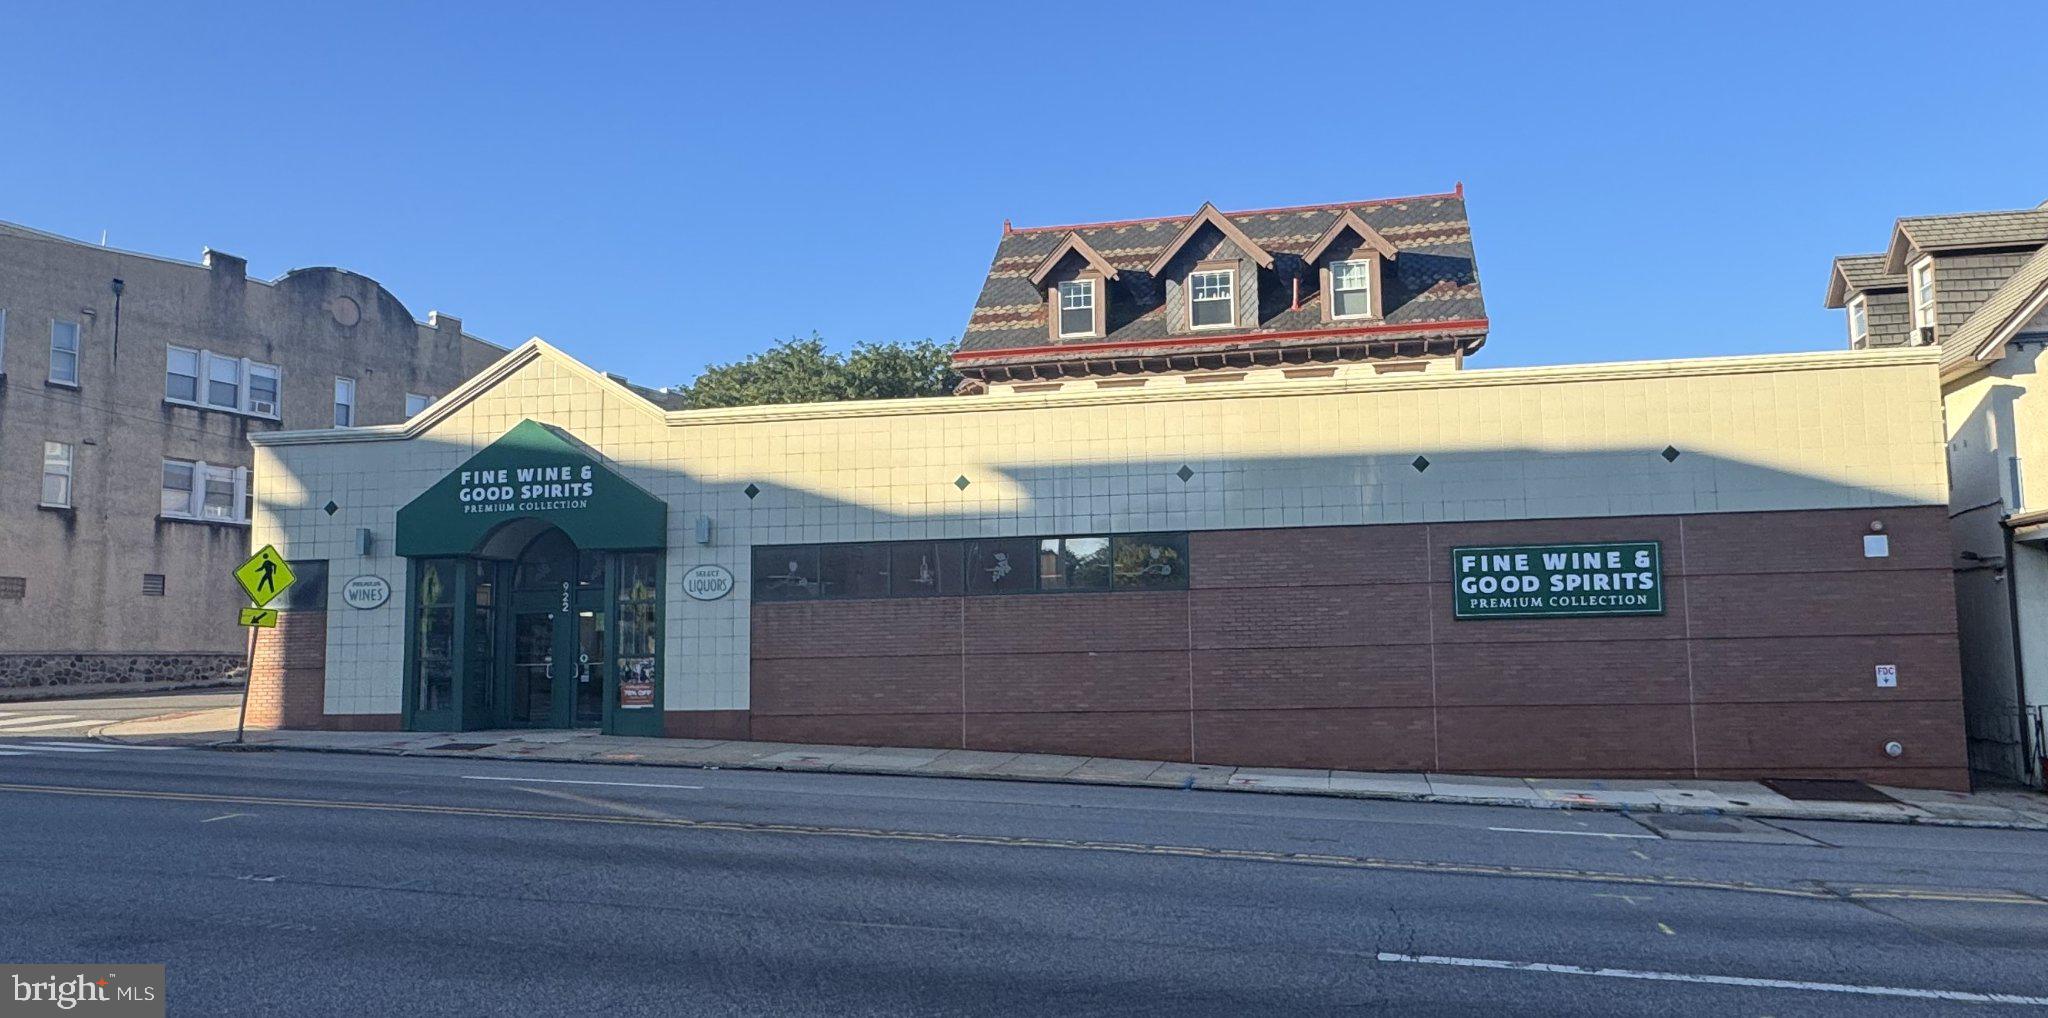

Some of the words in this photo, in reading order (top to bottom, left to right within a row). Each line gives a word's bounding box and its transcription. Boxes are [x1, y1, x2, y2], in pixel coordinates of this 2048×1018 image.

[461, 469, 508, 485] FINE
[517, 466, 572, 483] WINE
[581, 465, 592, 480] &
[459, 486, 514, 502] GOOD
[520, 482, 593, 499] SPIRITS
[464, 503, 515, 514] PREMIUM
[519, 500, 588, 511] COLLECTION
[1461, 554, 1530, 573] FINE
[1542, 551, 1622, 571] WINE
[1634, 550, 1651, 568] &
[689, 579, 727, 595] LIQUORS
[1461, 575, 1540, 594] GOOD
[1550, 572, 1654, 592] SPIRITS
[348, 588, 383, 601] WINES
[1470, 597, 1543, 609] PREMIUM
[1549, 594, 1648, 607] COLLECTION
[1877, 666, 1895, 675] FDC
